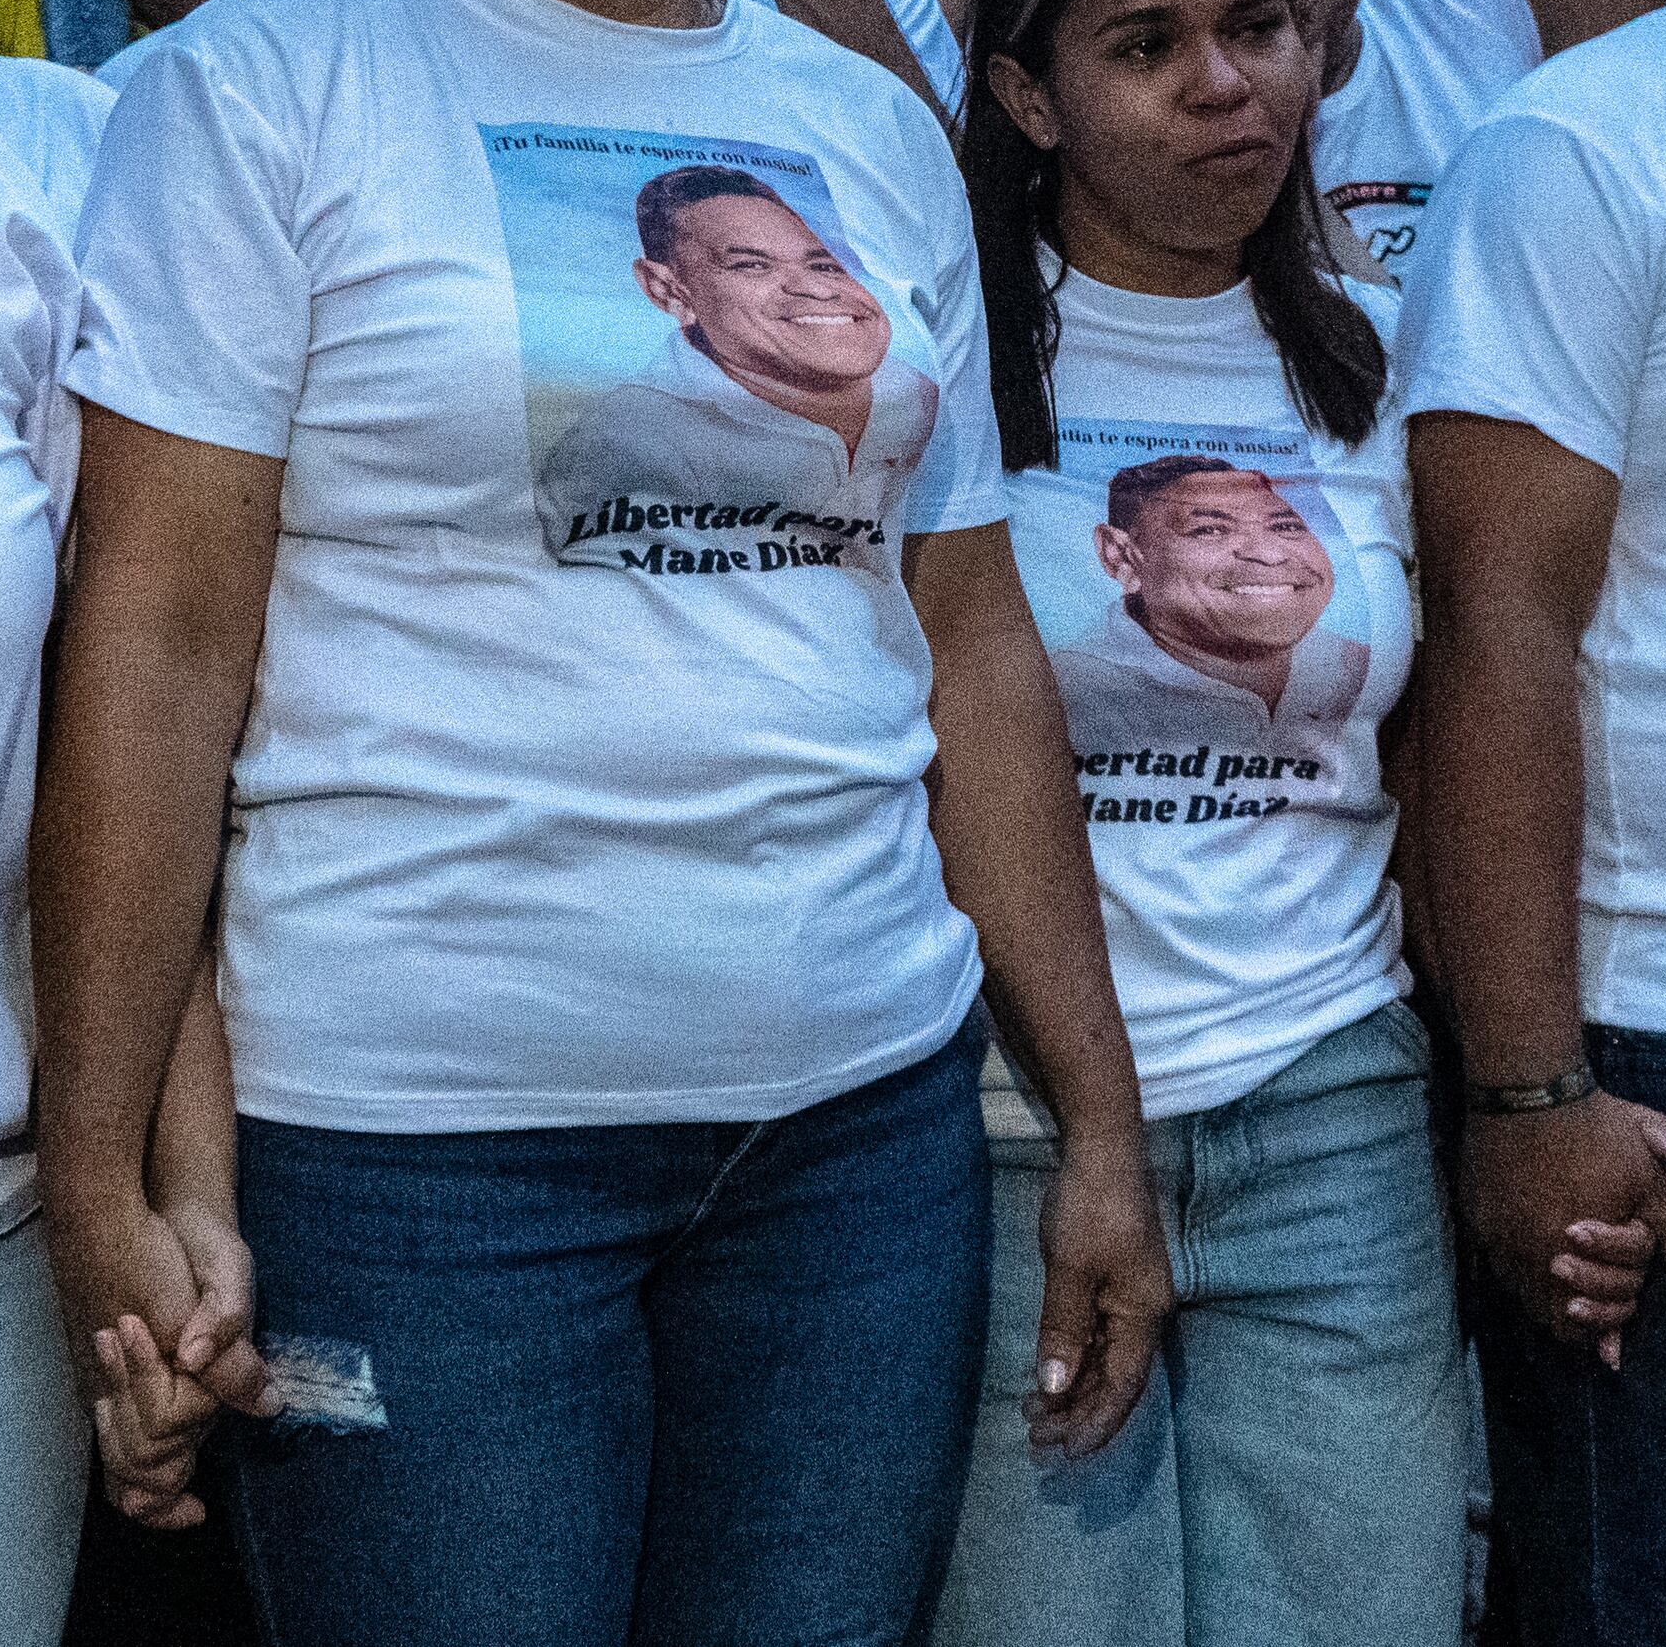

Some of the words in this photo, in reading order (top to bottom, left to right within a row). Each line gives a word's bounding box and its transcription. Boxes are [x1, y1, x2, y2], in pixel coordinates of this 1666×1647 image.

[533, 134, 609, 154] familia
[614, 140, 634, 155] te
[640, 145, 707, 162] espera
[712, 151, 746, 165] con
[1099, 430, 1119, 445] te
[1124, 433, 1190, 451] espera
[564, 497, 781, 548] Libertad
[620, 544, 751, 575] Mane
[757, 536, 843, 572] Díaz
[1213, 753, 1321, 786] para
[1185, 792, 1289, 824] Díaz
